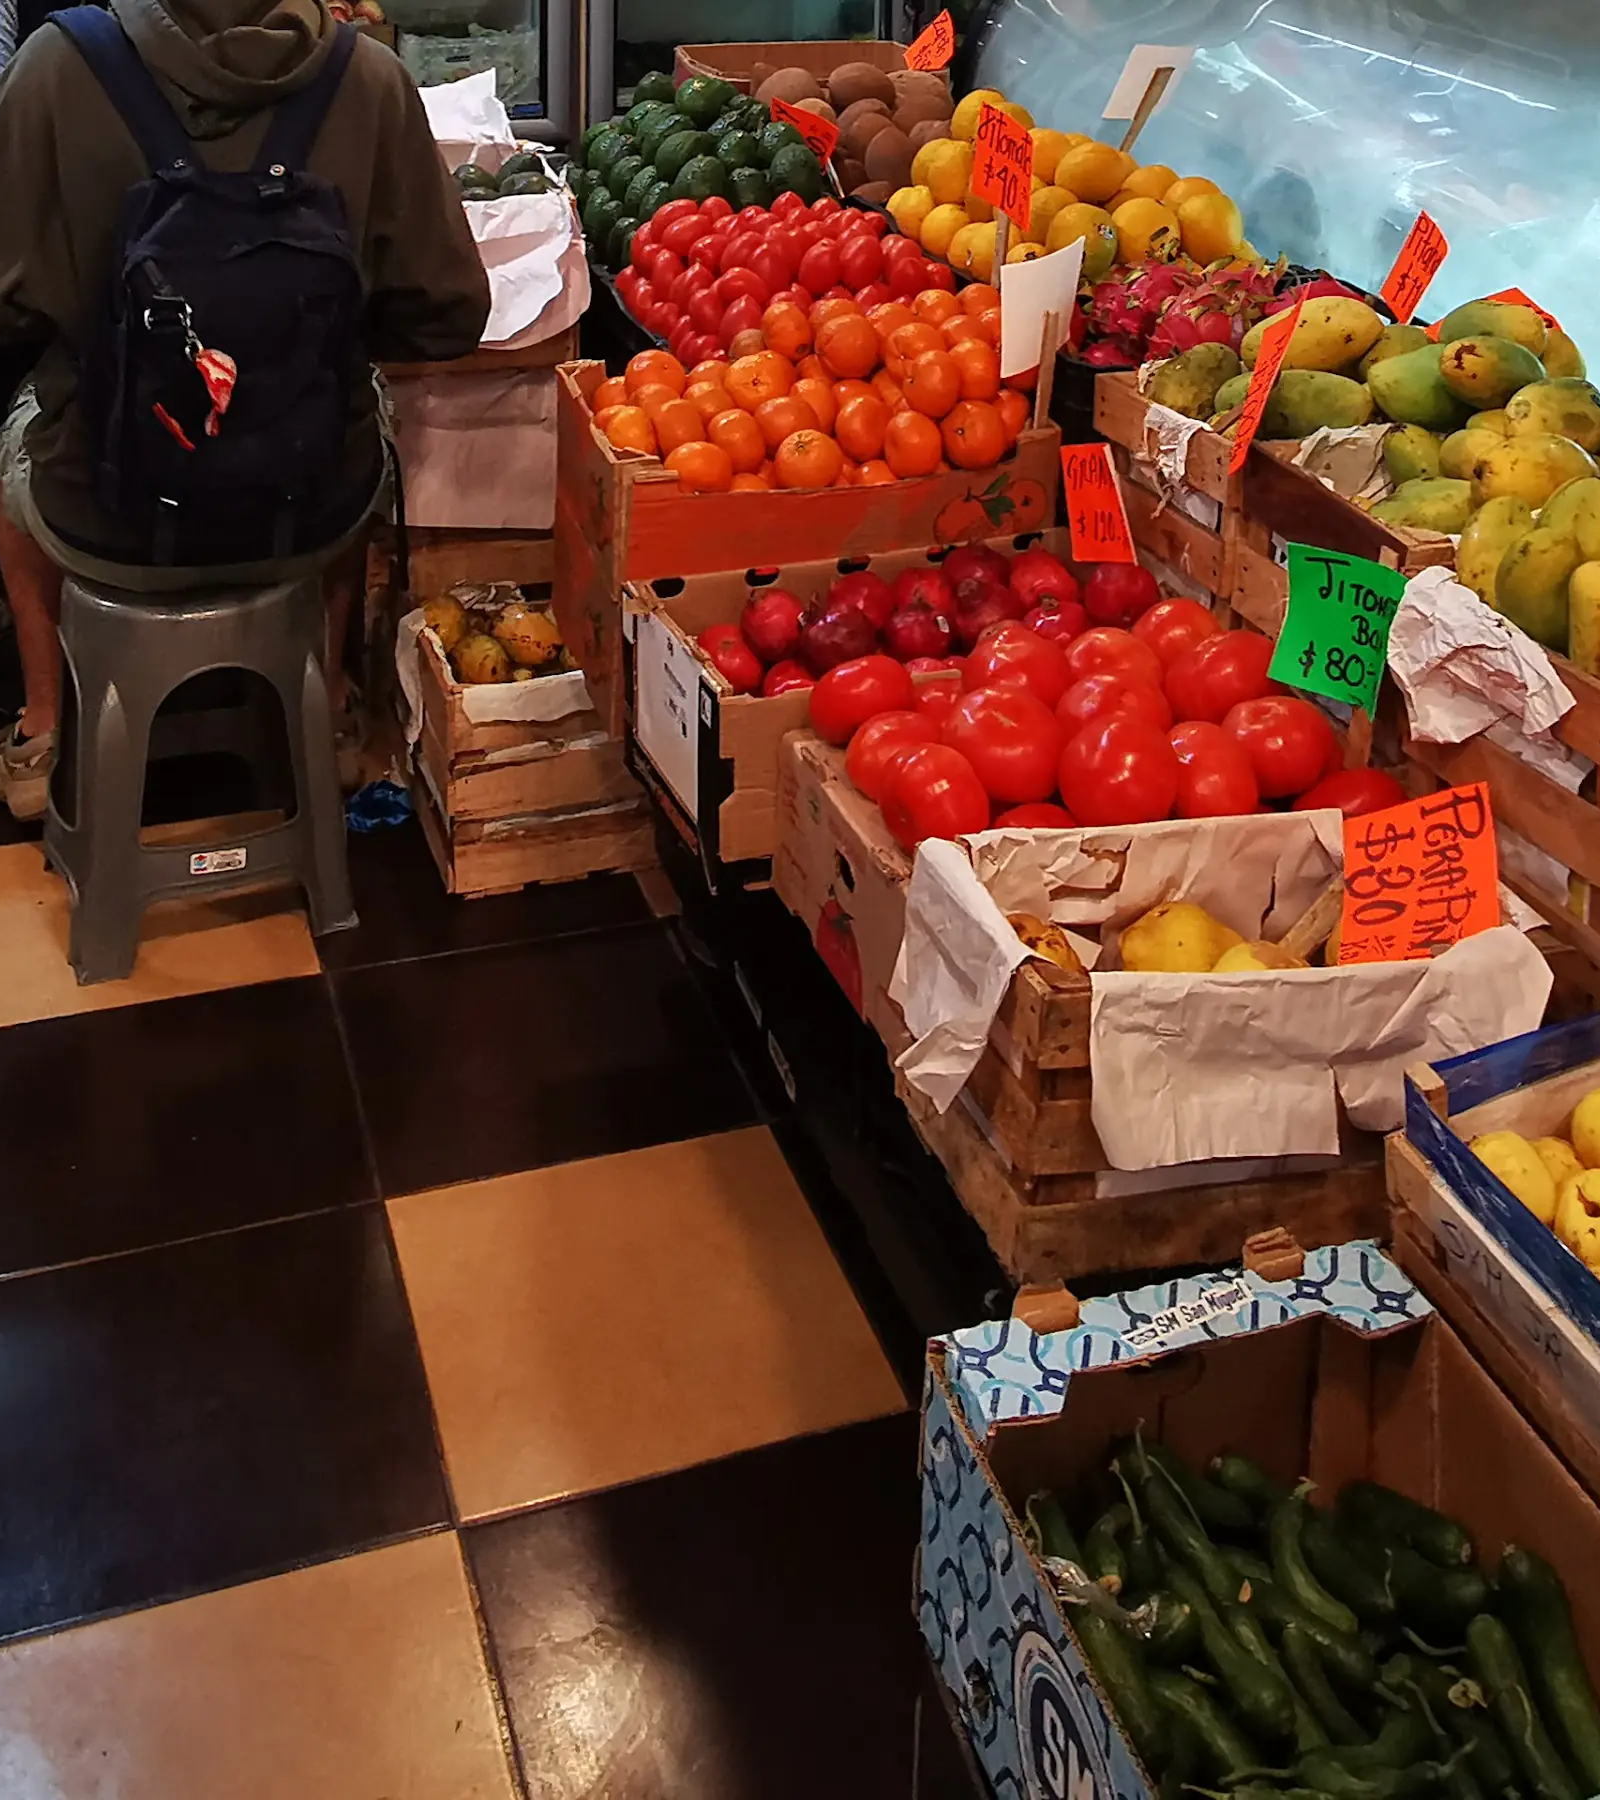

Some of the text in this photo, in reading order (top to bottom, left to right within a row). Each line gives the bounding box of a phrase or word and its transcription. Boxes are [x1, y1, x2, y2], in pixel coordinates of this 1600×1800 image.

[1067, 455, 1114, 491] GRAN
[1345, 823, 1414, 926] $30
[1154, 1278, 1252, 1333] SM San Miguel
